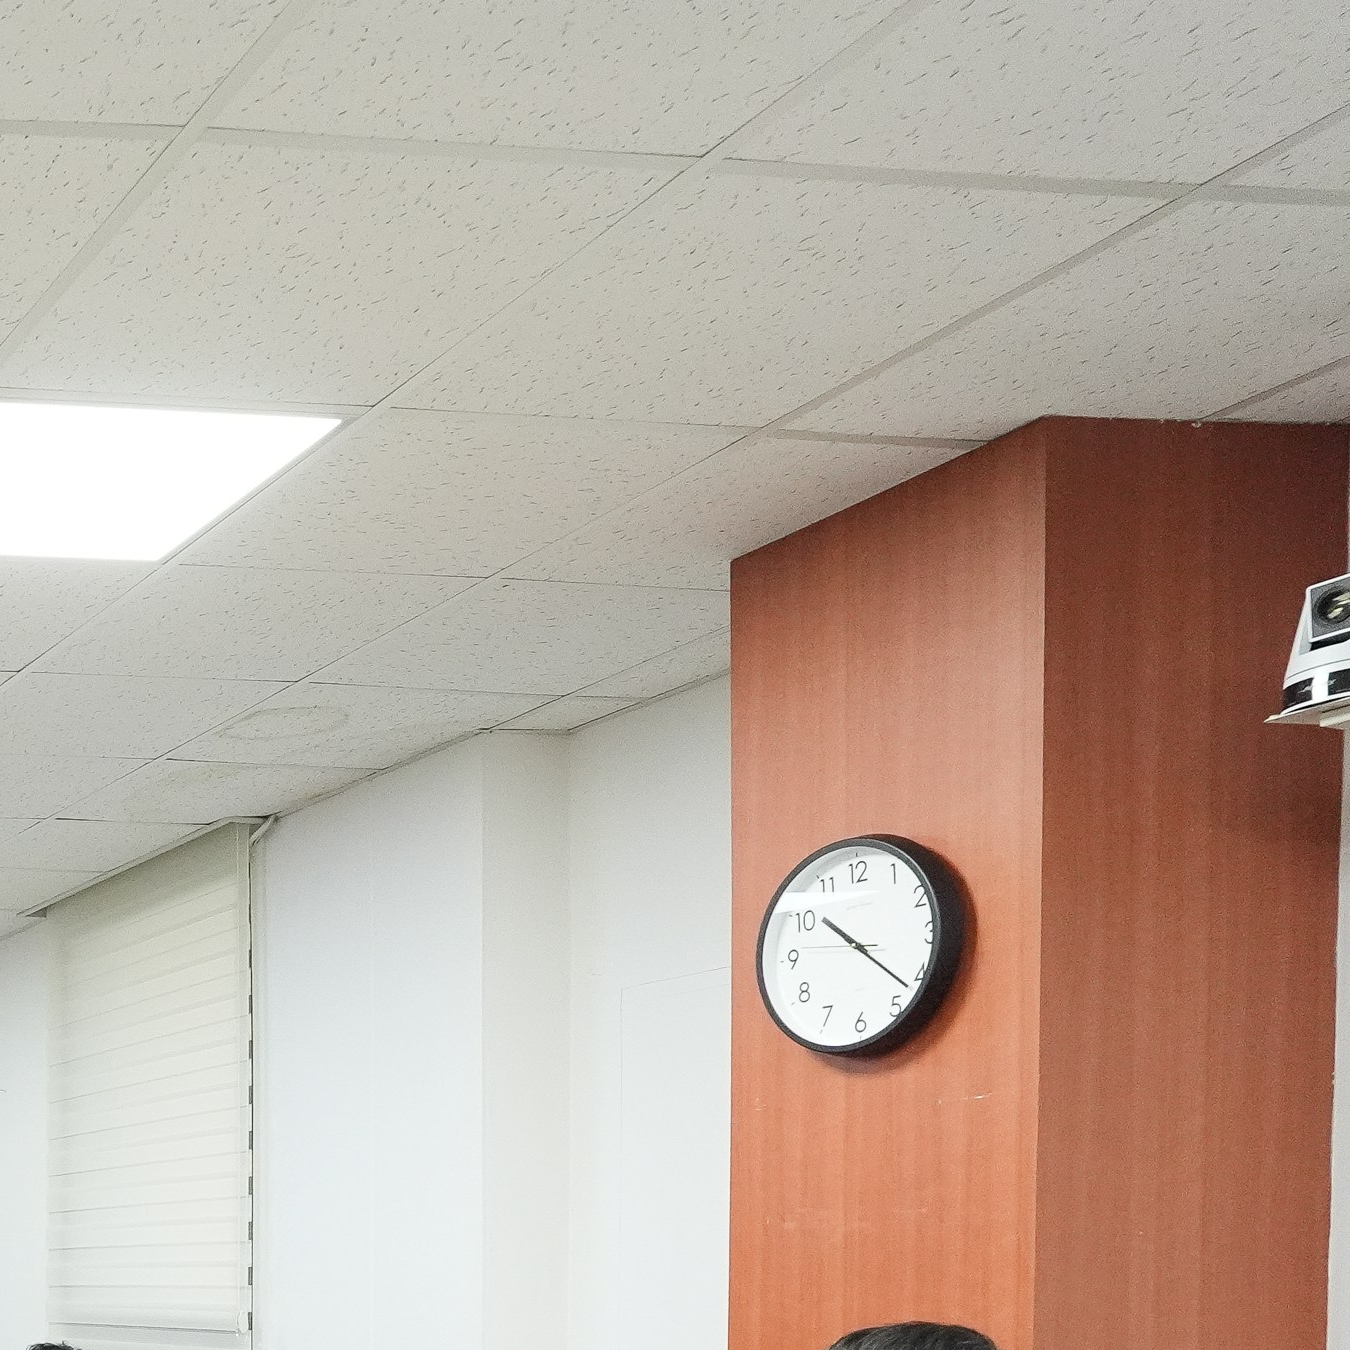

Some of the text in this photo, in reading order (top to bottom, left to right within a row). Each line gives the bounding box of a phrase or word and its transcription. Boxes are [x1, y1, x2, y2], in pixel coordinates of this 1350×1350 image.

[849, 860, 868, 884] 12
[890, 863, 897, 884] 1
[820, 877, 835, 892] 11
[914, 884, 927, 908] 2
[795, 910, 815, 932] 10
[788, 949, 799, 970] 9
[799, 982, 810, 1002] 8
[822, 1005, 833, 1027] 7
[890, 995, 901, 1017] 5
[855, 1012, 867, 1033] 6
